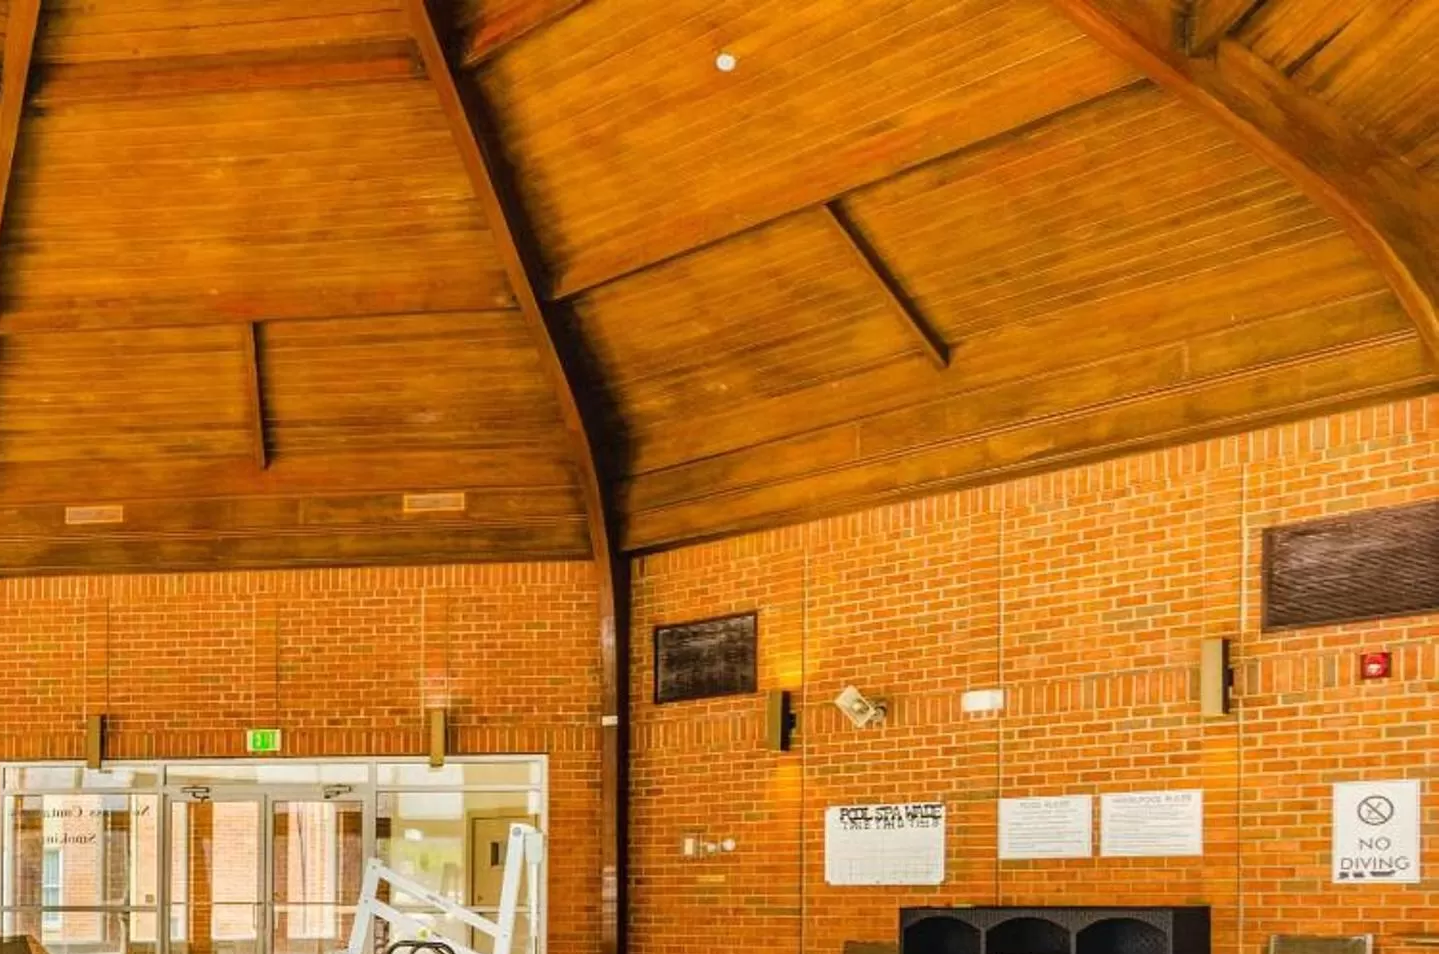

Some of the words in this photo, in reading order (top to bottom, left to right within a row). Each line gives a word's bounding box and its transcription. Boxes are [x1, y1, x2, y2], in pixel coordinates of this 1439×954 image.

[839, 807, 873, 821] POOL
[875, 806, 903, 820] SPA
[1360, 835, 1391, 852] NO
[1340, 855, 1411, 871] DIVING
